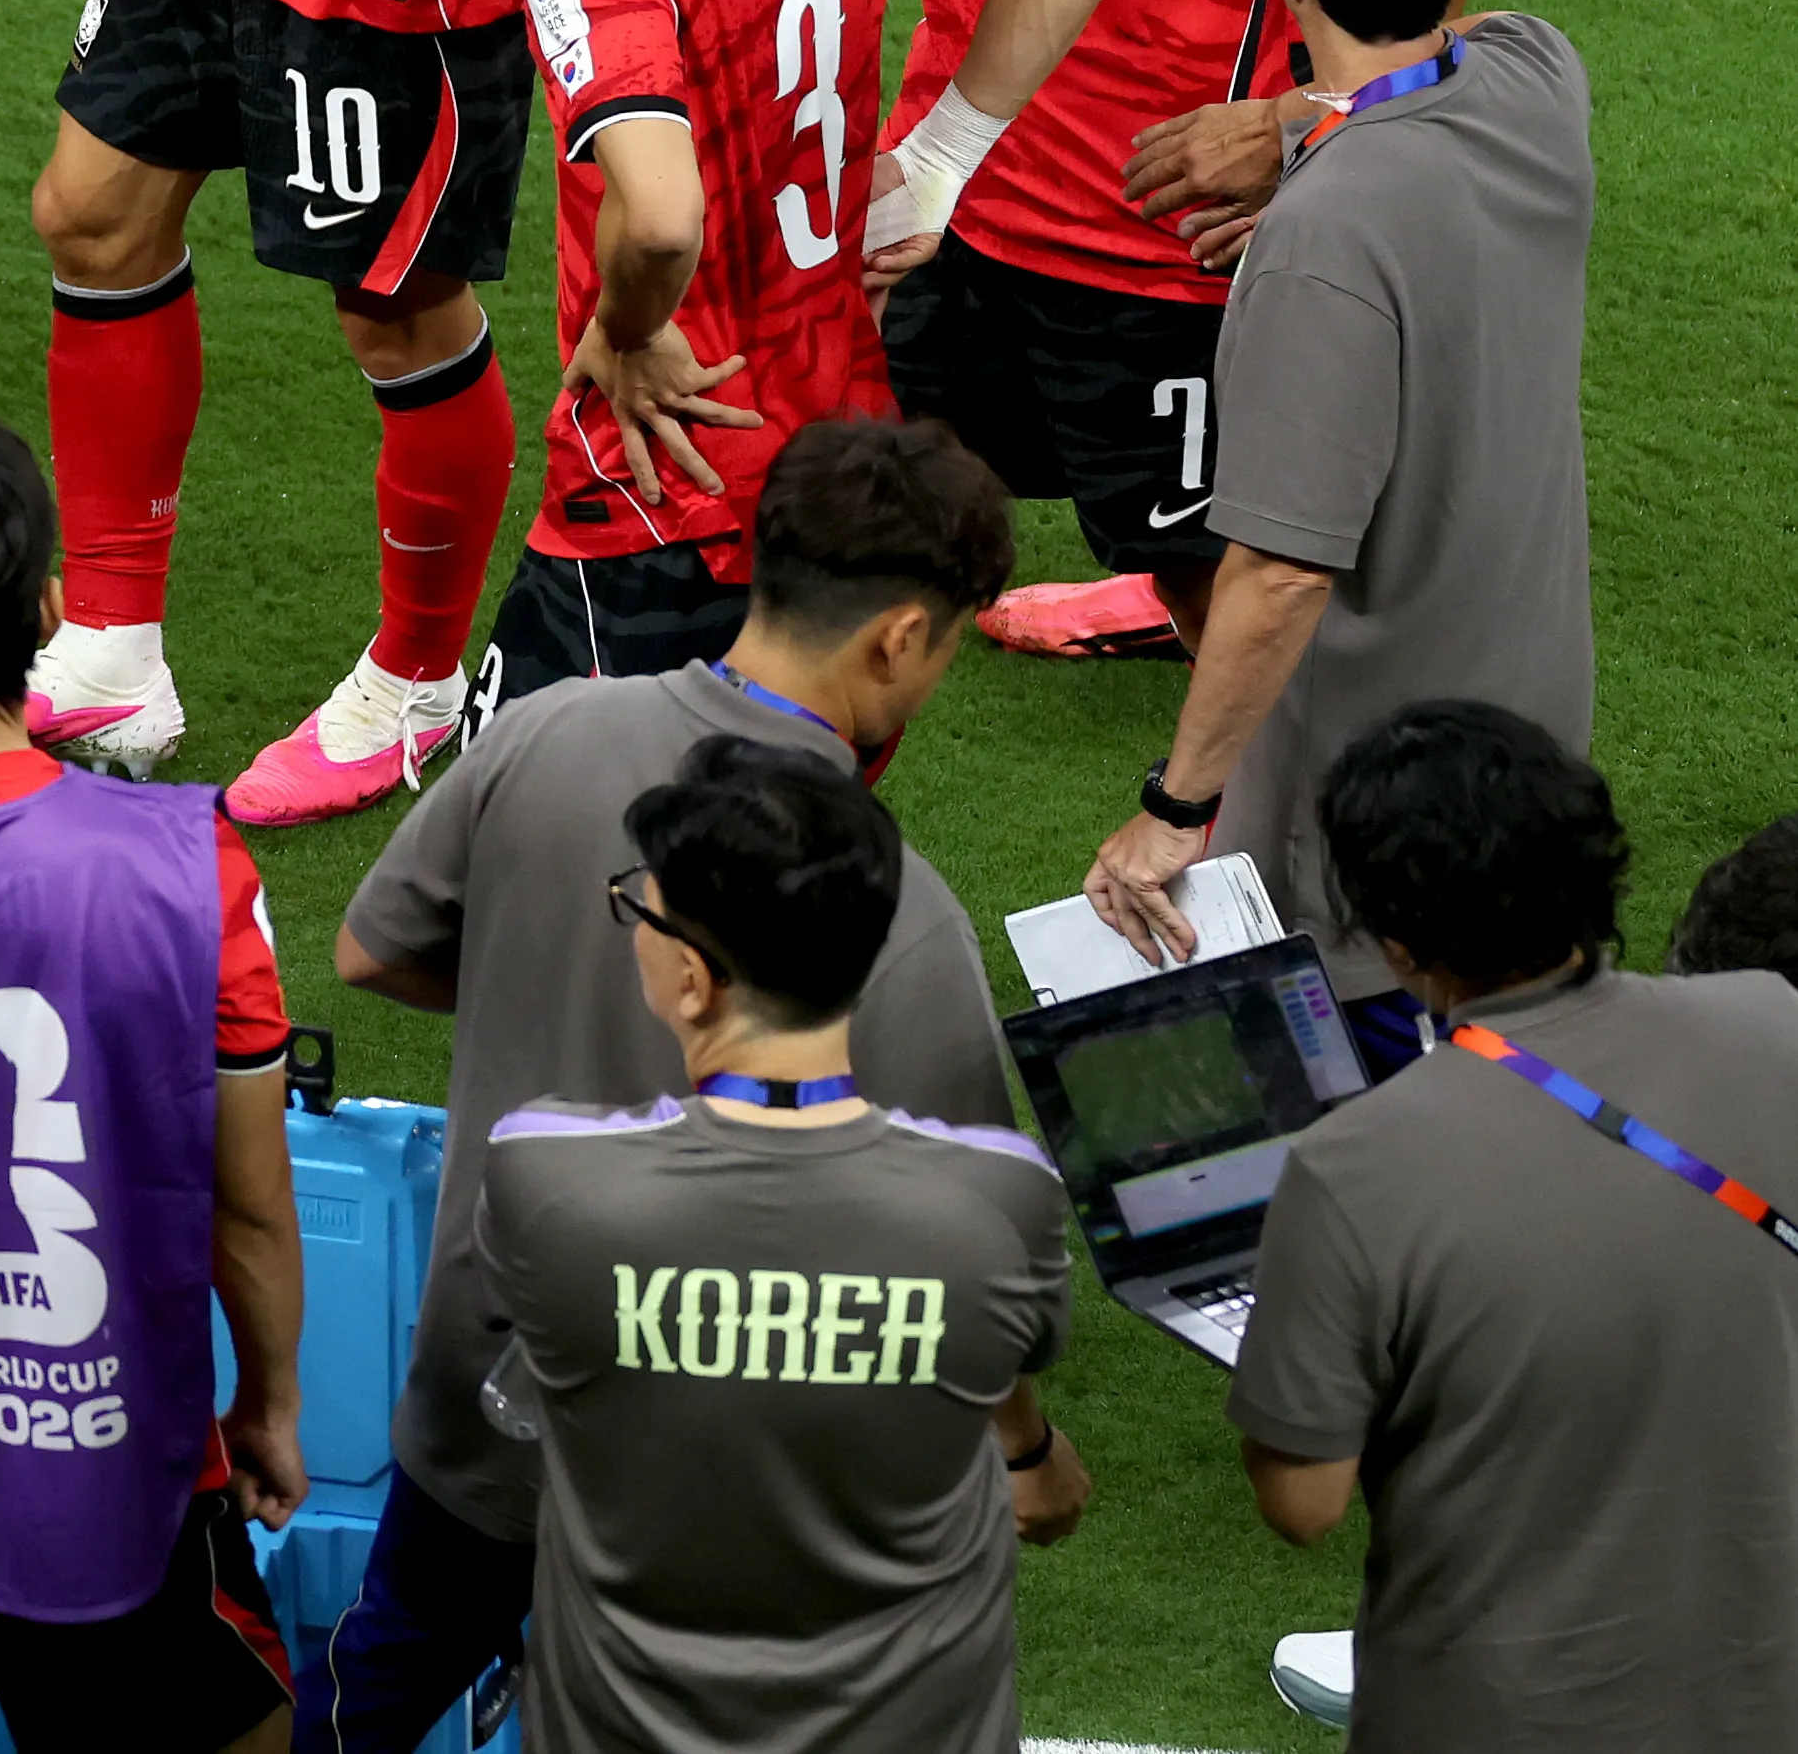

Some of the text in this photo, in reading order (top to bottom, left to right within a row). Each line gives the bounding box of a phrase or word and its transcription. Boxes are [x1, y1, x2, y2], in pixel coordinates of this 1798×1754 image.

[285, 68, 382, 205] 10
[1151, 377, 1207, 490] 7
[47, 1356, 120, 1394] CUP
[612, 1263, 946, 1385] KOREA
